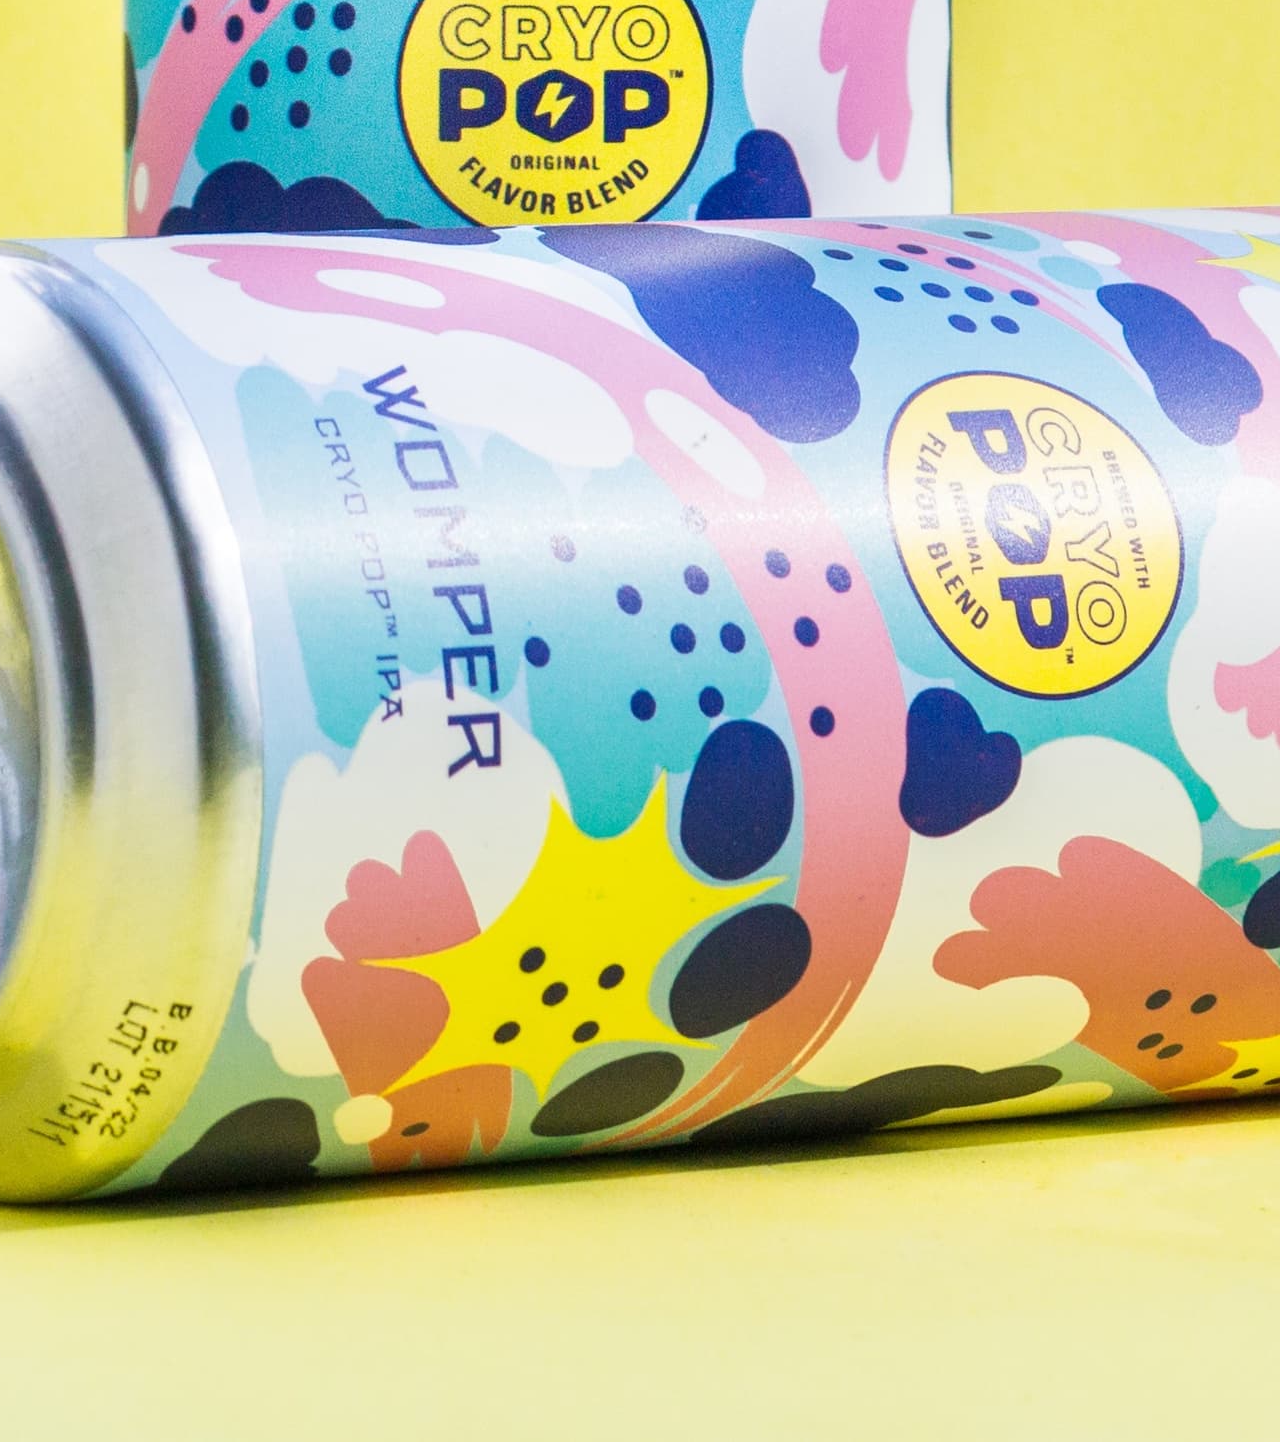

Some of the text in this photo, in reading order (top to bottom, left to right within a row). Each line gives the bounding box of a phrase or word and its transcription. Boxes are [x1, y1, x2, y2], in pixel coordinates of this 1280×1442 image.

[439, 4, 670, 62] CRYO
[458, 155, 650, 215] FLAVOR BLEND
[510, 154, 601, 171] ORIGINAL
[314, 417, 368, 515] CRYO
[375, 654, 403, 723] IPA
[1025, 406, 1128, 646] CRYO
[1127, 537, 1151, 590] WITH
[361, 364, 502, 779] WOMPER
[926, 541, 990, 630] BLEND
[27, 999, 159, 1147] LOT 211511
